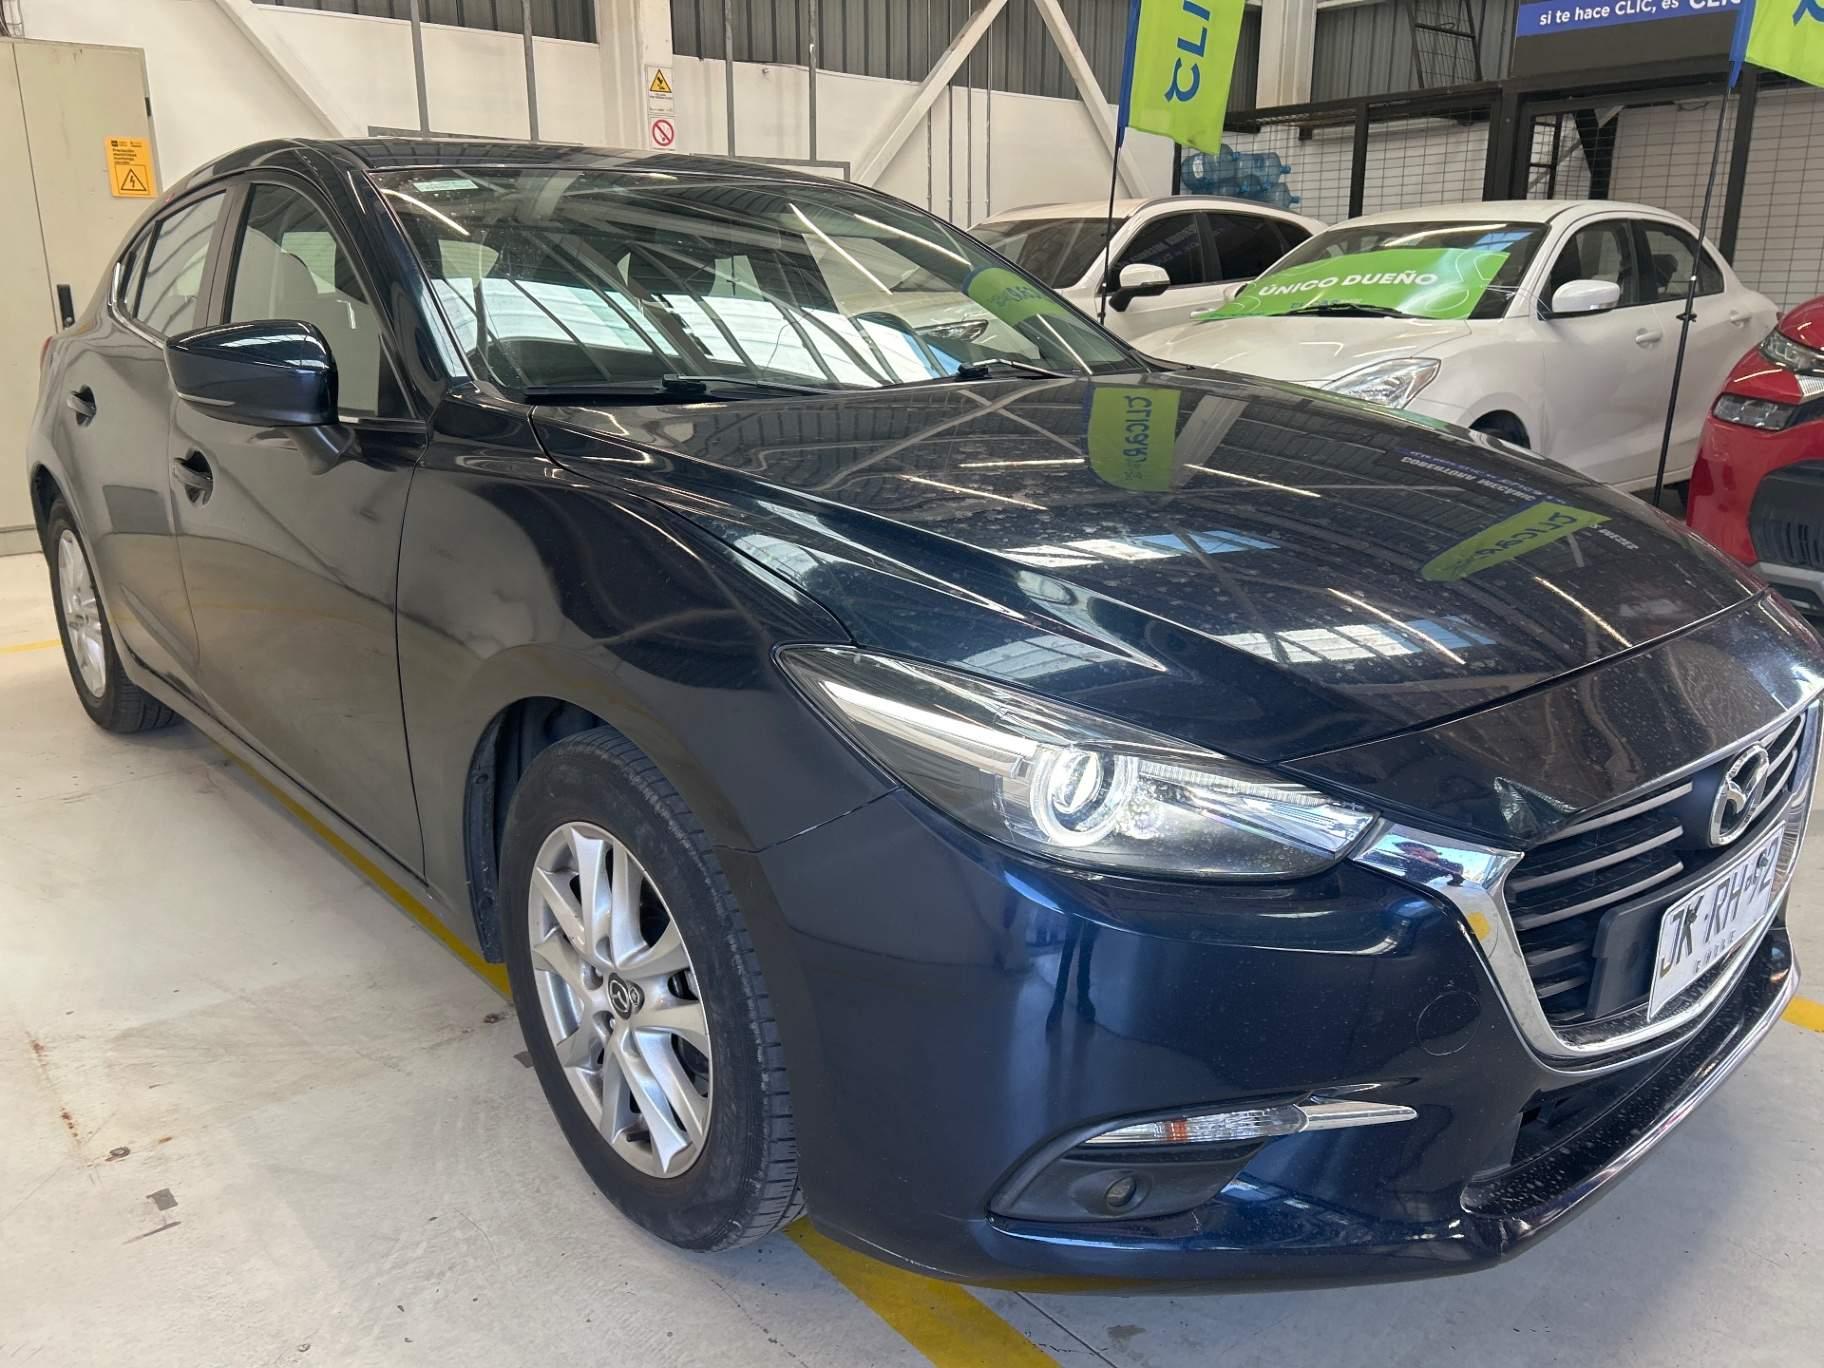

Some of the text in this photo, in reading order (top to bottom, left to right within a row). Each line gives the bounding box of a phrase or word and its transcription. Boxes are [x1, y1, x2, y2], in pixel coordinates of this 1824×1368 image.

[1539, 11, 1552, 25] si
[1555, 11, 1570, 24] te
[1575, 6, 1610, 21] hace
[1661, 0, 1679, 9] es
[1258, 270, 1439, 296] ÚNICO DUEÑO
